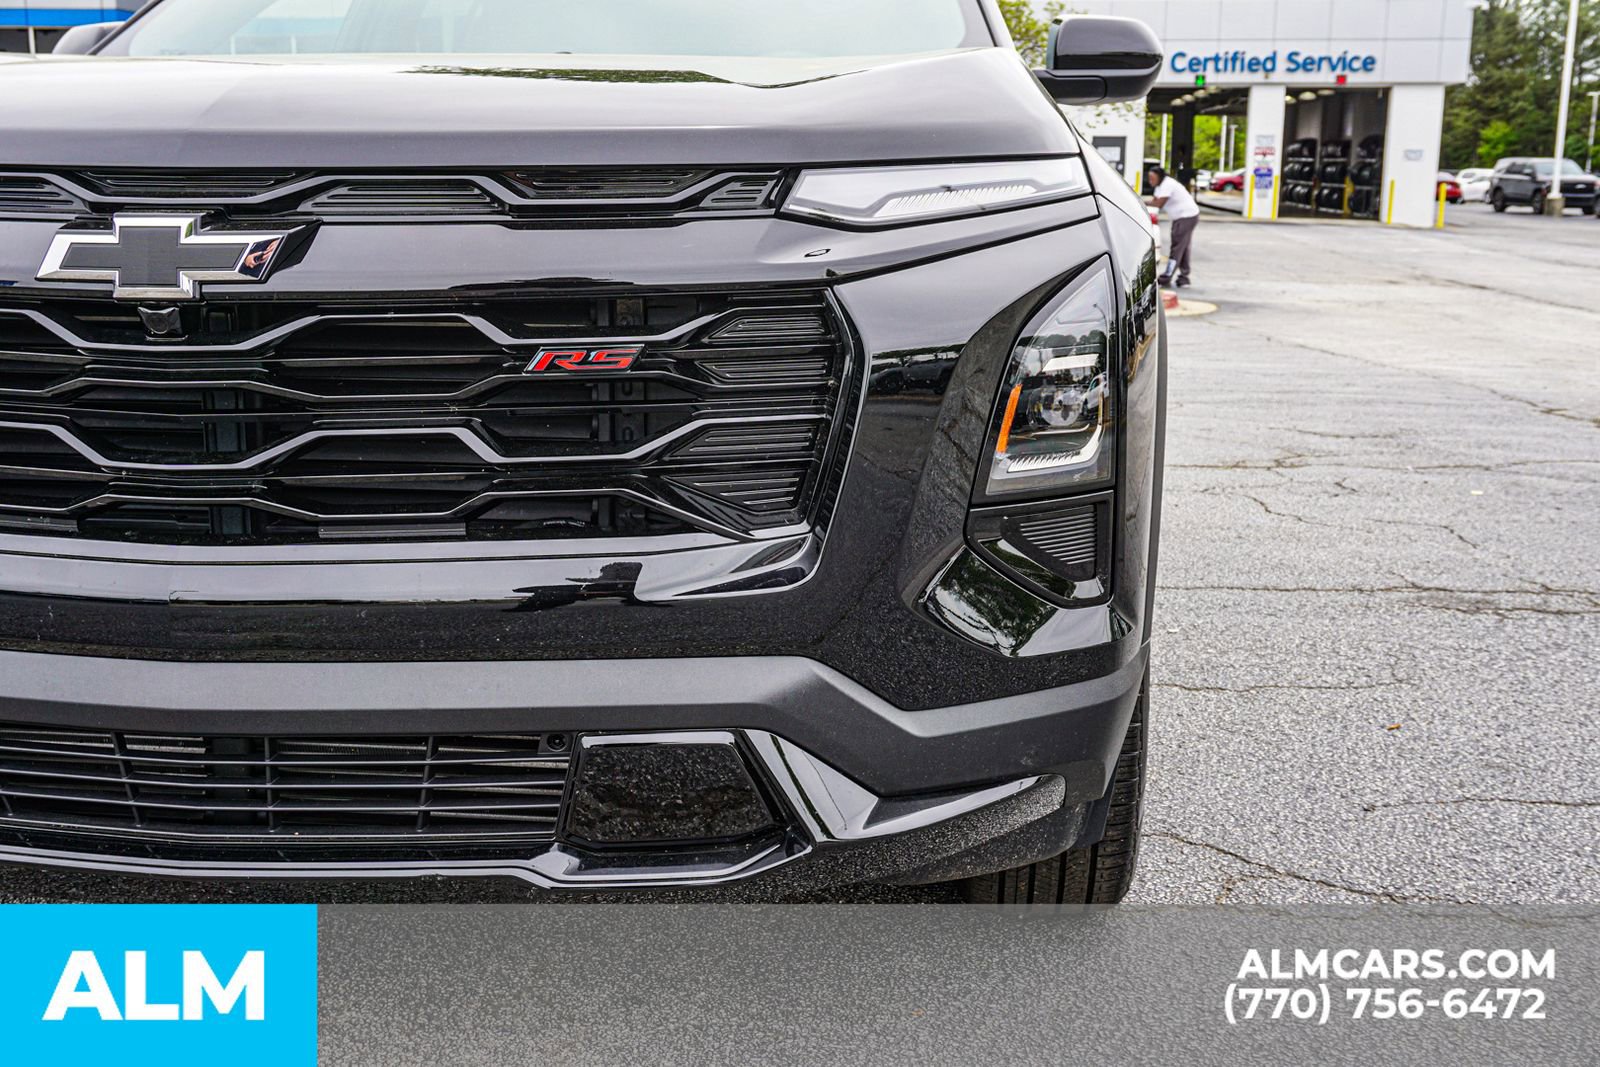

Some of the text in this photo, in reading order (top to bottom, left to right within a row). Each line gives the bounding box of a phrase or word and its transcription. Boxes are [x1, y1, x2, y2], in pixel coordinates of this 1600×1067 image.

[1170, 50, 1377, 73] Certified Service
[527, 347, 639, 371] RS
